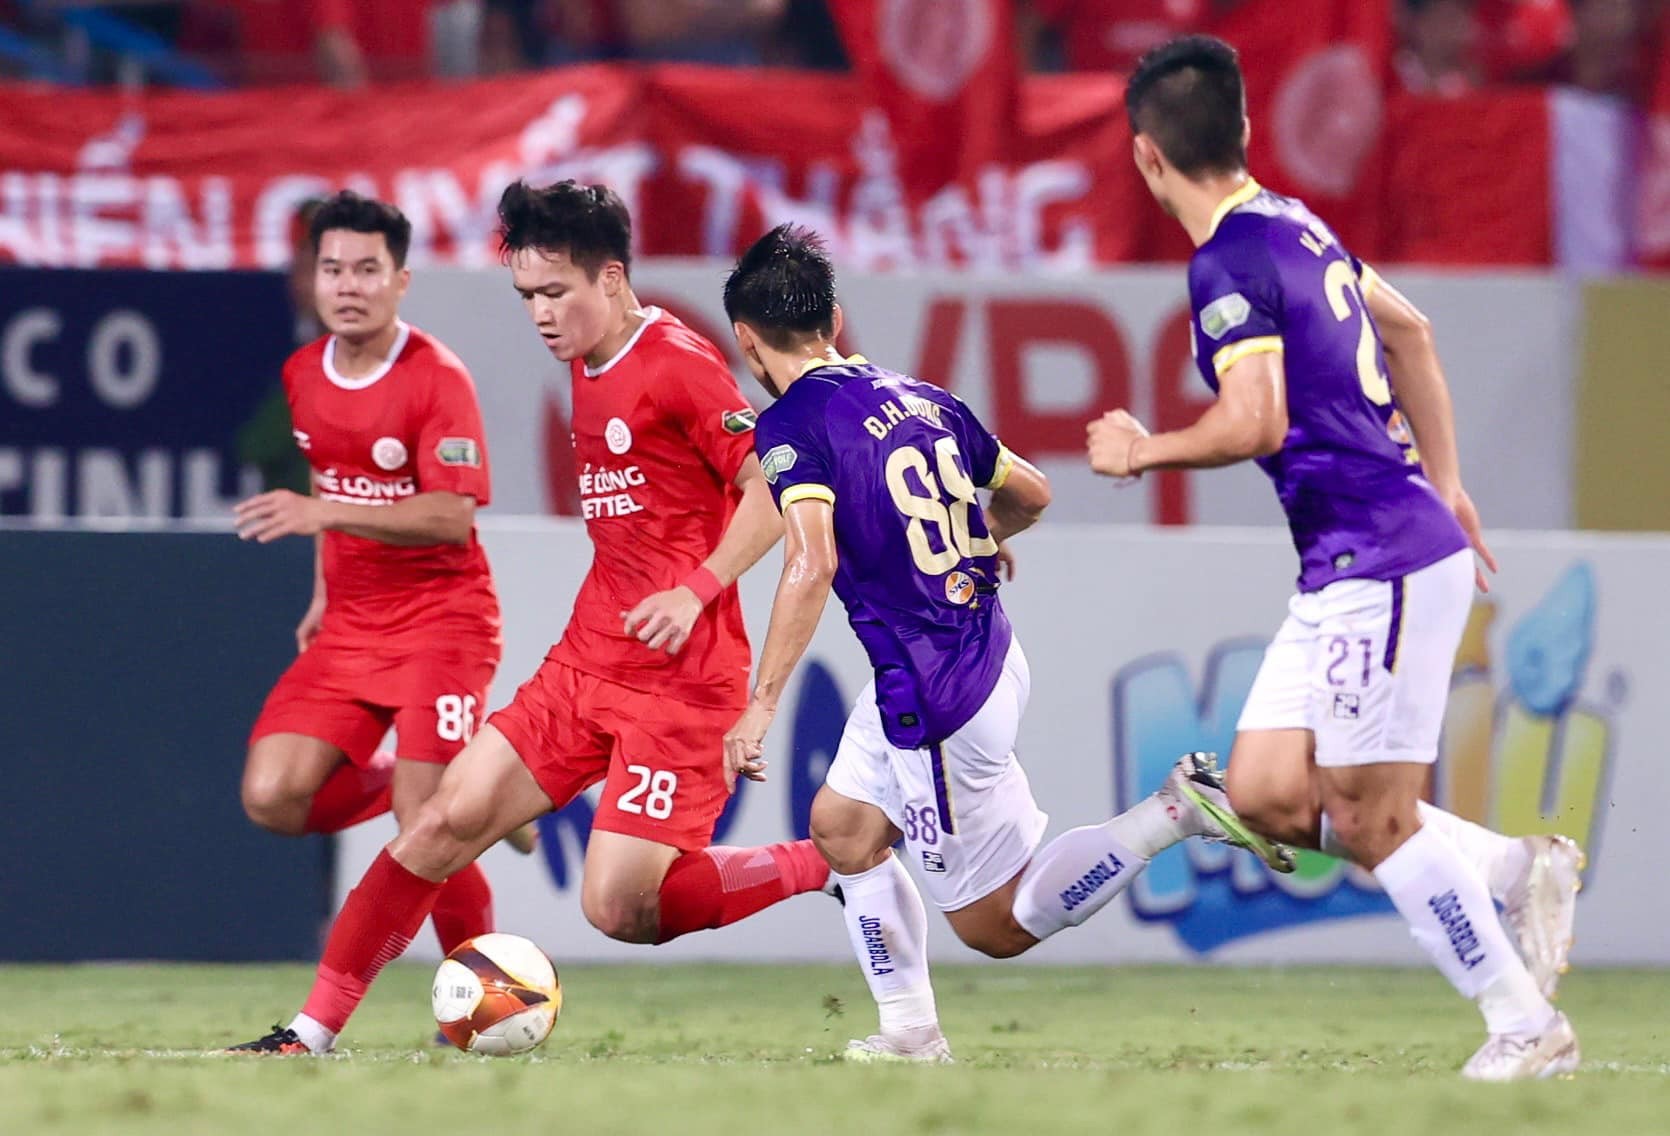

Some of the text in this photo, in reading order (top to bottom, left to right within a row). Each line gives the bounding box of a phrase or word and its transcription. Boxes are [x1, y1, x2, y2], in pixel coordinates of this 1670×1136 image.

[885, 436, 999, 576] 88
[1327, 635, 1371, 687] 21
[617, 765, 677, 820] 28
[904, 803, 938, 845] 88
[859, 915, 895, 976] JOGARBOLA
